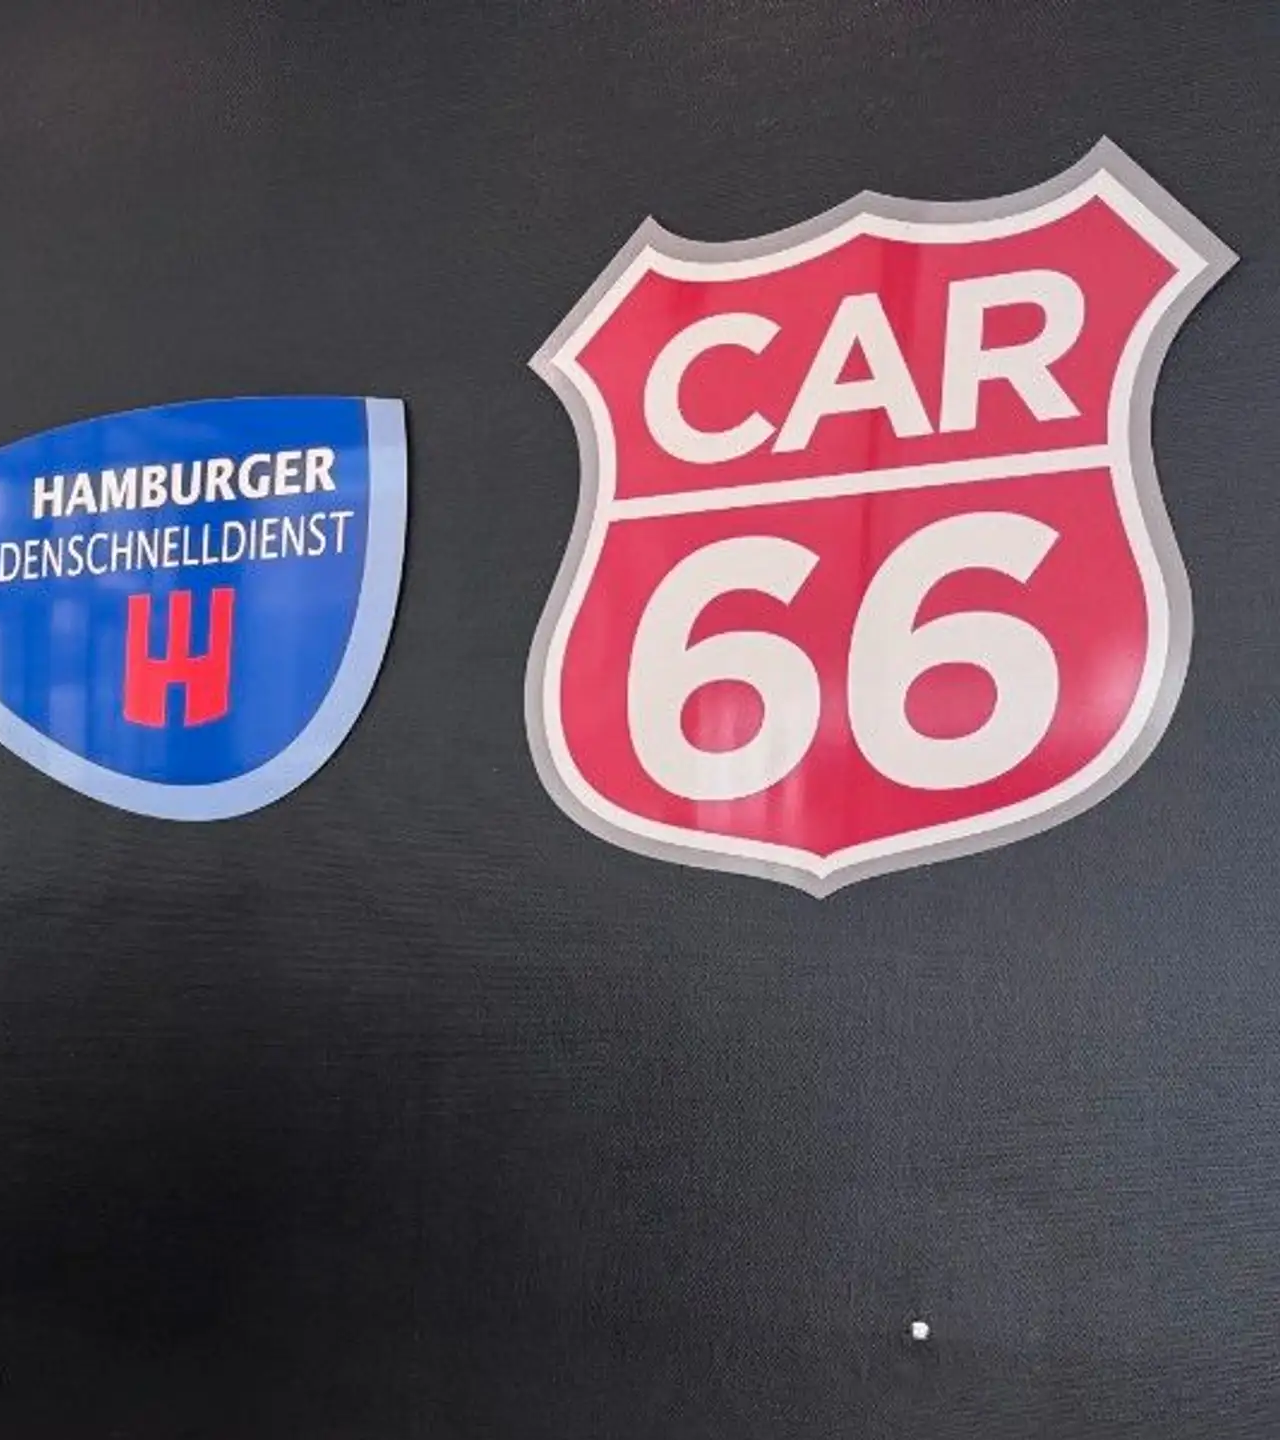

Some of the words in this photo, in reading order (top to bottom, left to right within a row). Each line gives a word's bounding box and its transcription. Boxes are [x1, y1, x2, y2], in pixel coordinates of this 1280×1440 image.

[643, 268, 1085, 464] CAR
[32, 446, 337, 520] HAMBURGER
[627, 511, 1060, 801] 66
